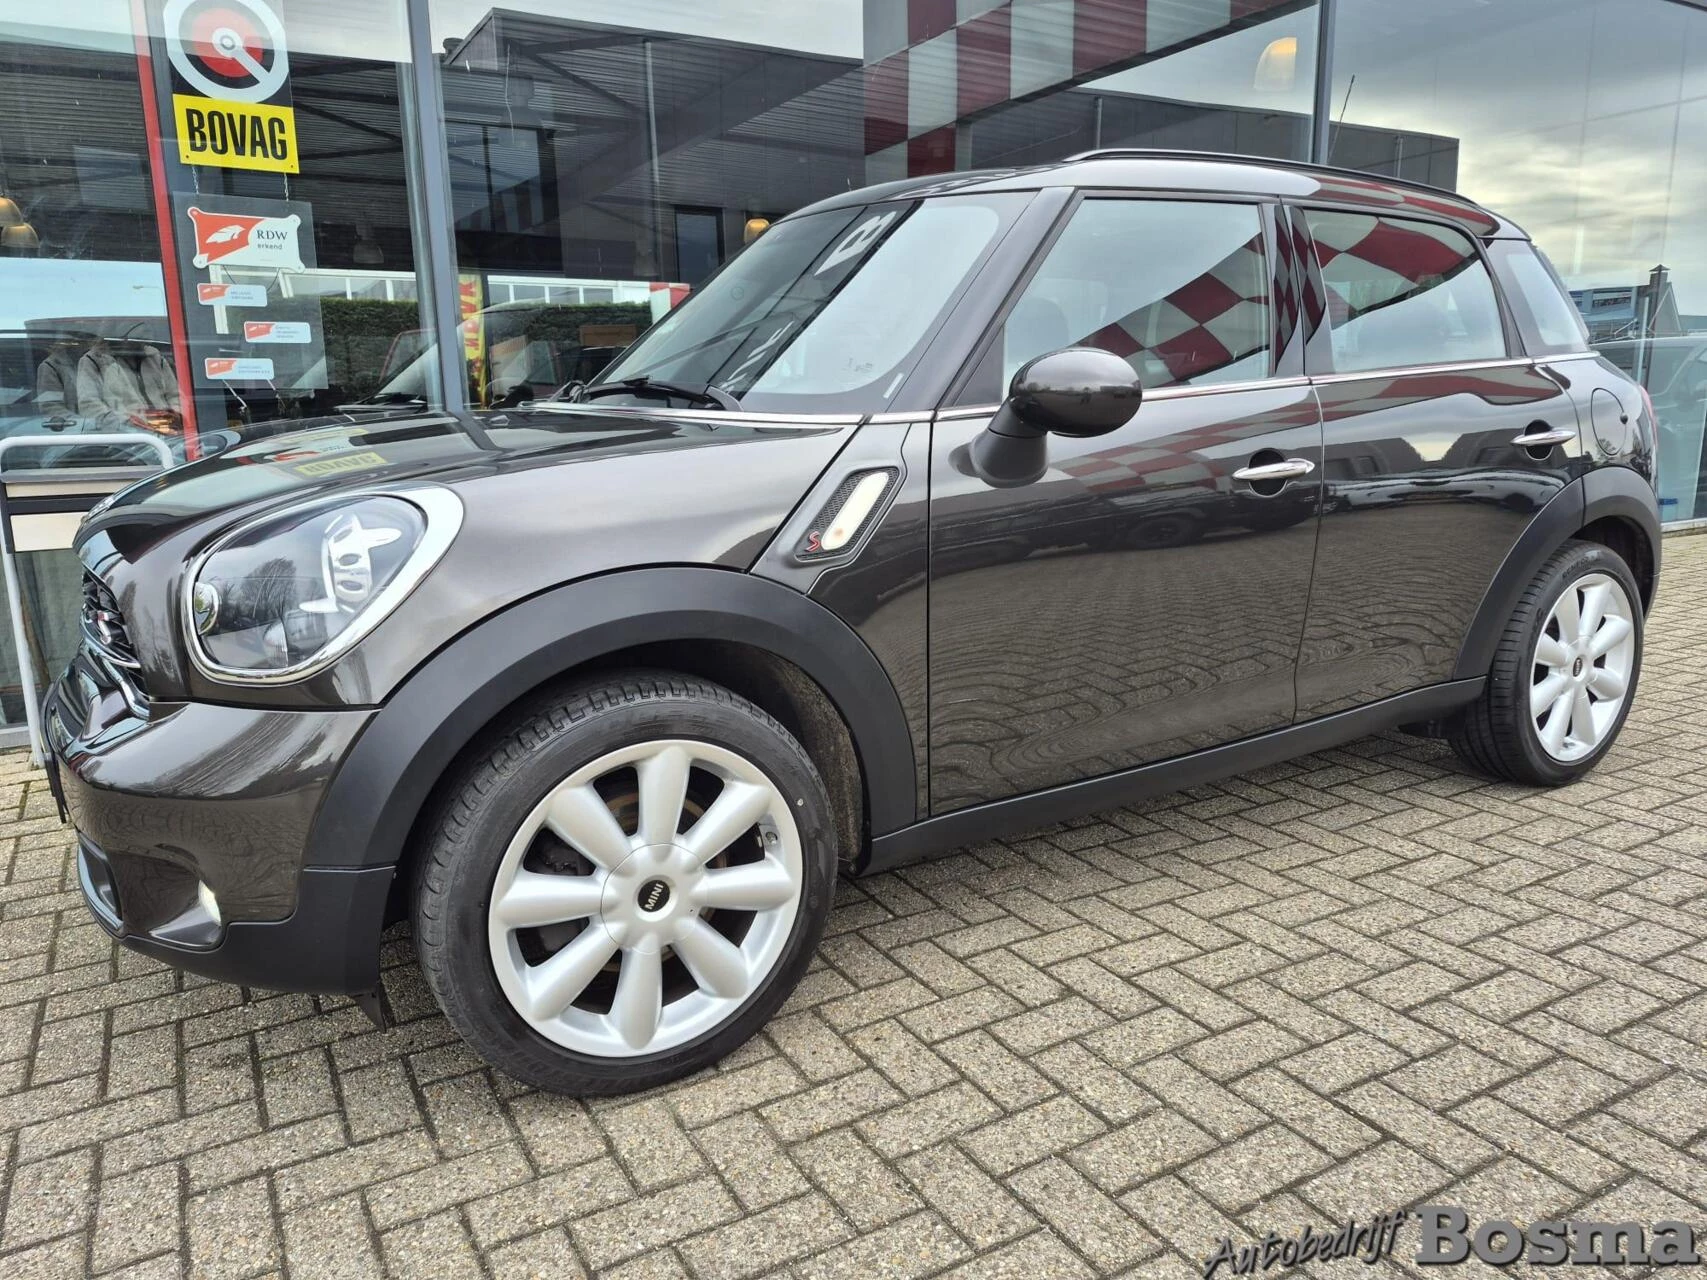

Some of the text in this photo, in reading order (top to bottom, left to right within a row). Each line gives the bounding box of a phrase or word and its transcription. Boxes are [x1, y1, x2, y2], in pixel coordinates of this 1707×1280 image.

[185, 108, 288, 160] BOVAG
[256, 230, 288, 240] RDW
[644, 883, 664, 910] MINI
